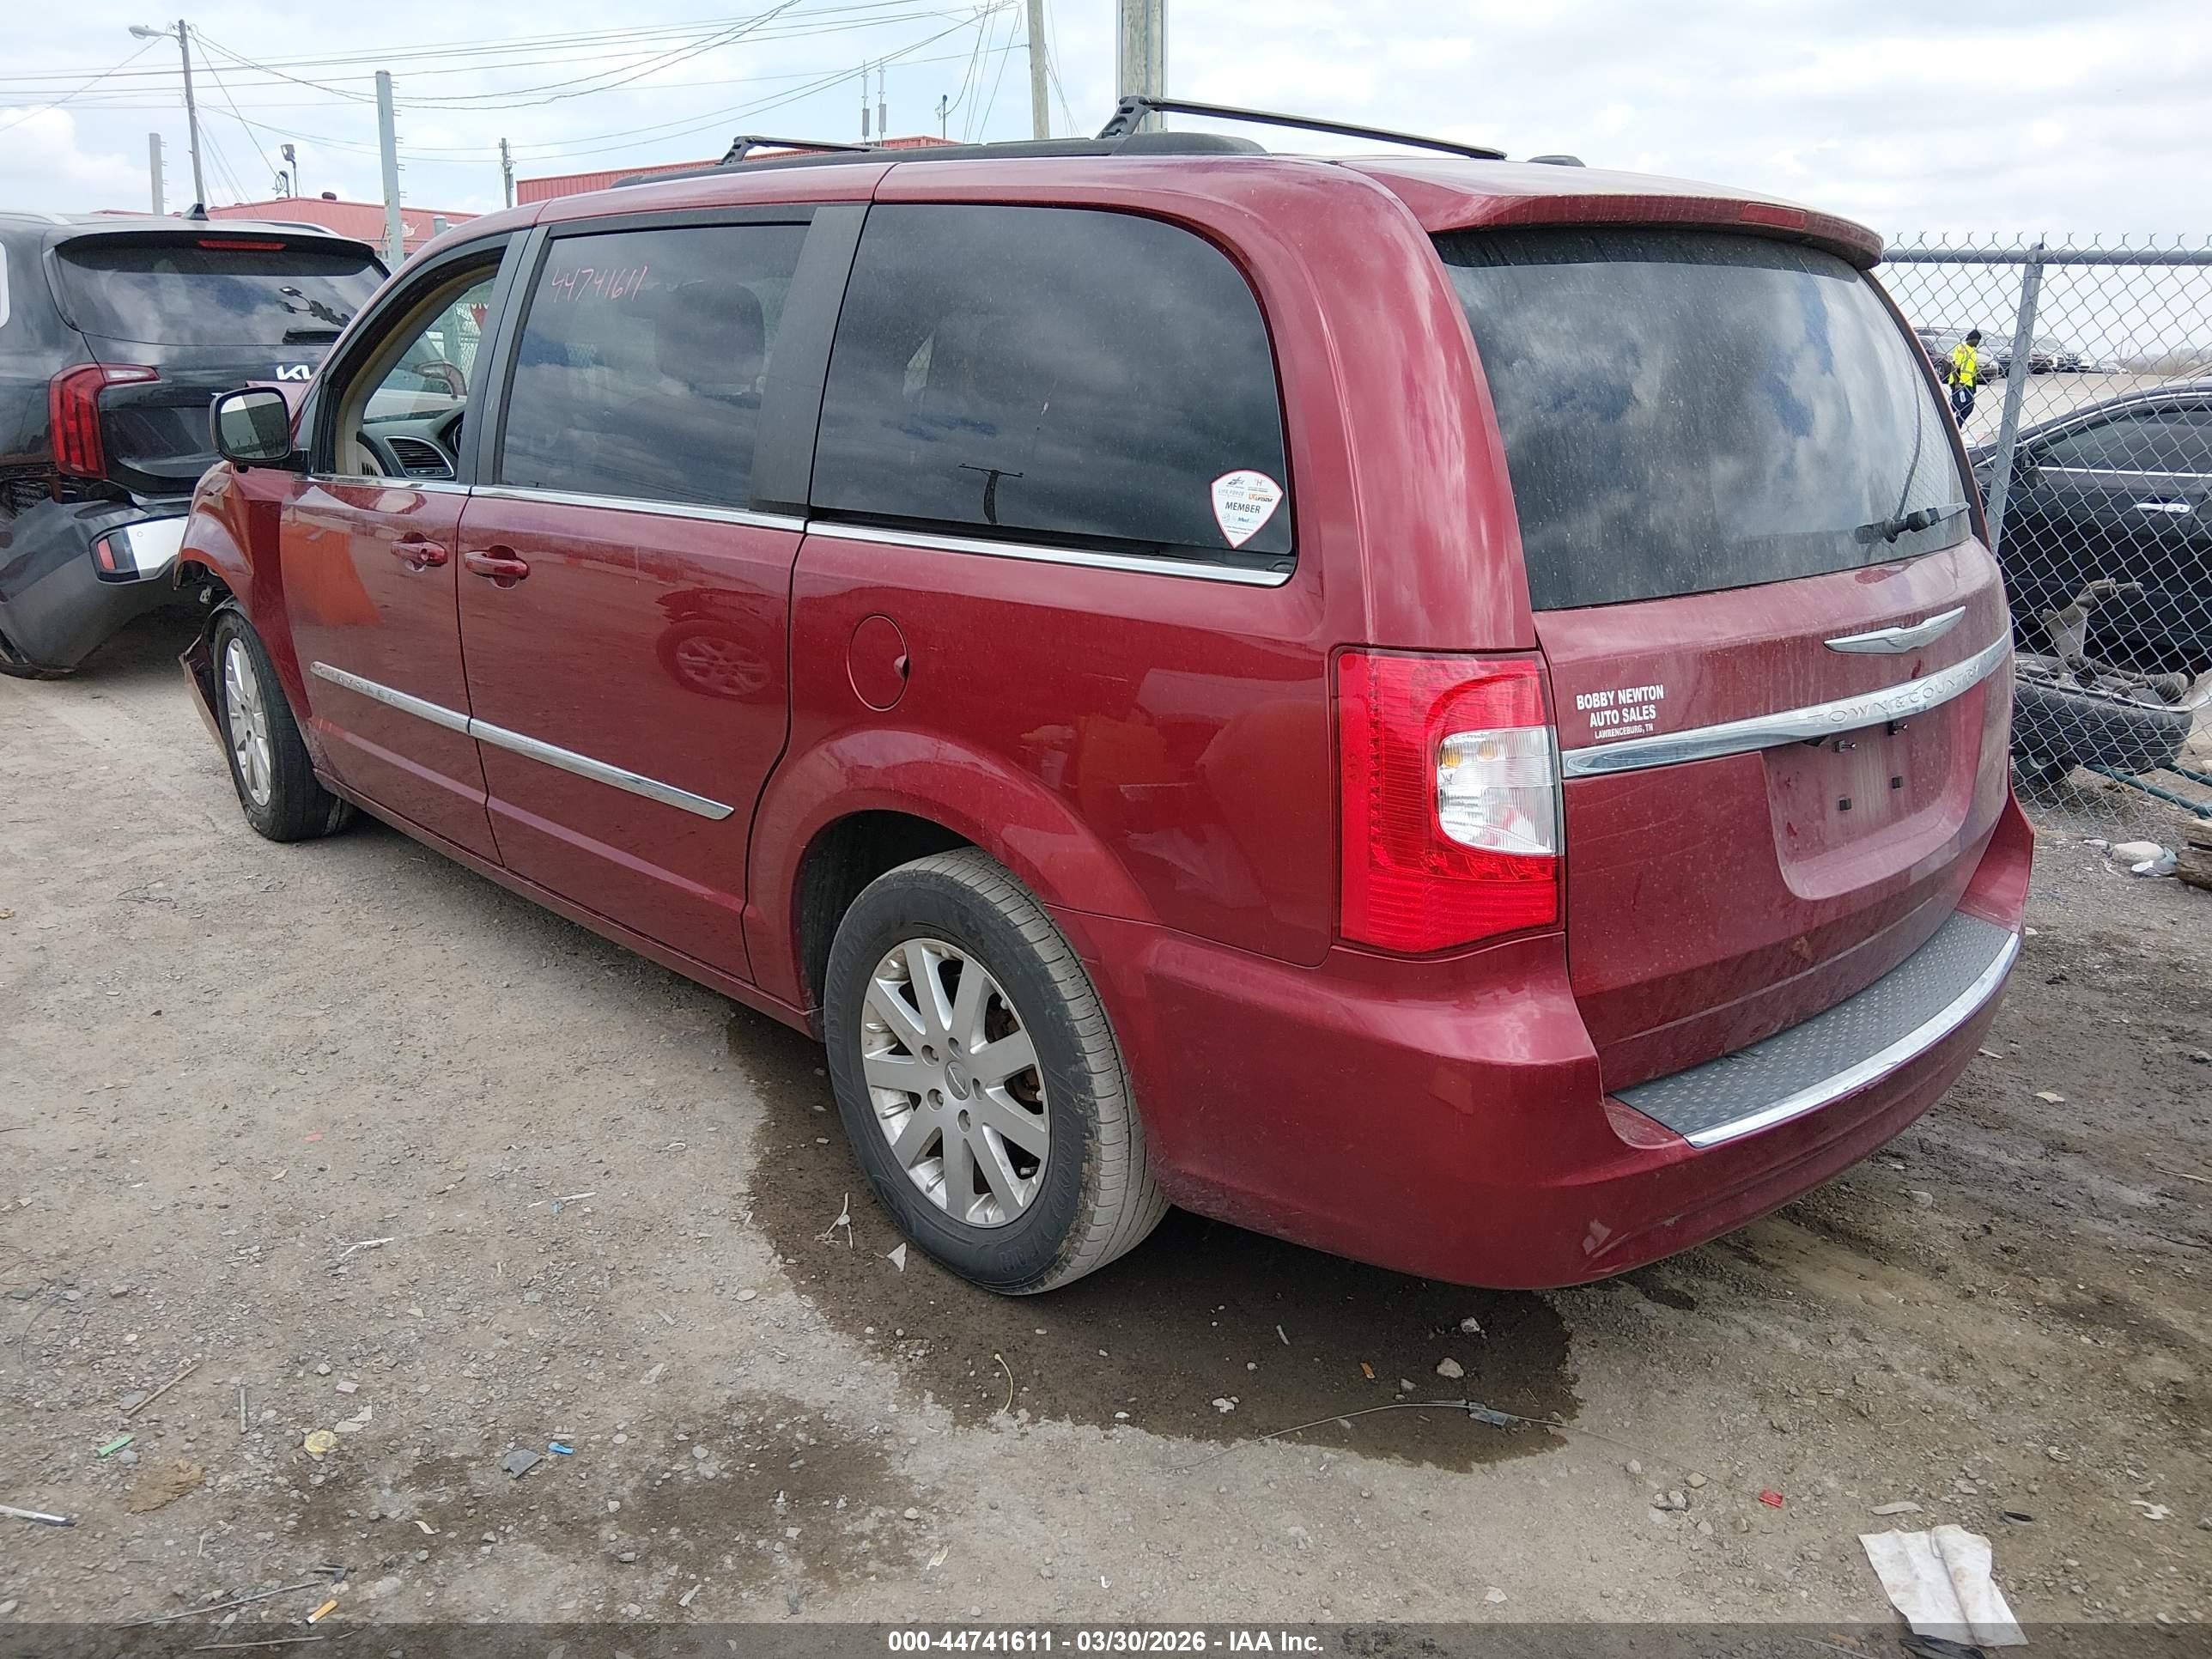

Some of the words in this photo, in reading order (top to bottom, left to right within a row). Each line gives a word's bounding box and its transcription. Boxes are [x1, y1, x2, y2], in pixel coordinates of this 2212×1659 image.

[551, 264, 648, 302] 44741611
[276, 365, 313, 380] KI
[1224, 501, 1261, 514] MEMBER
[1577, 690, 1615, 710] BOBBY
[1618, 684, 1664, 705] NEWTON
[1589, 709, 1620, 728] AUTO
[1621, 704, 1656, 723] SALES
[1595, 725, 1645, 739] LAWRENCEBURG,
